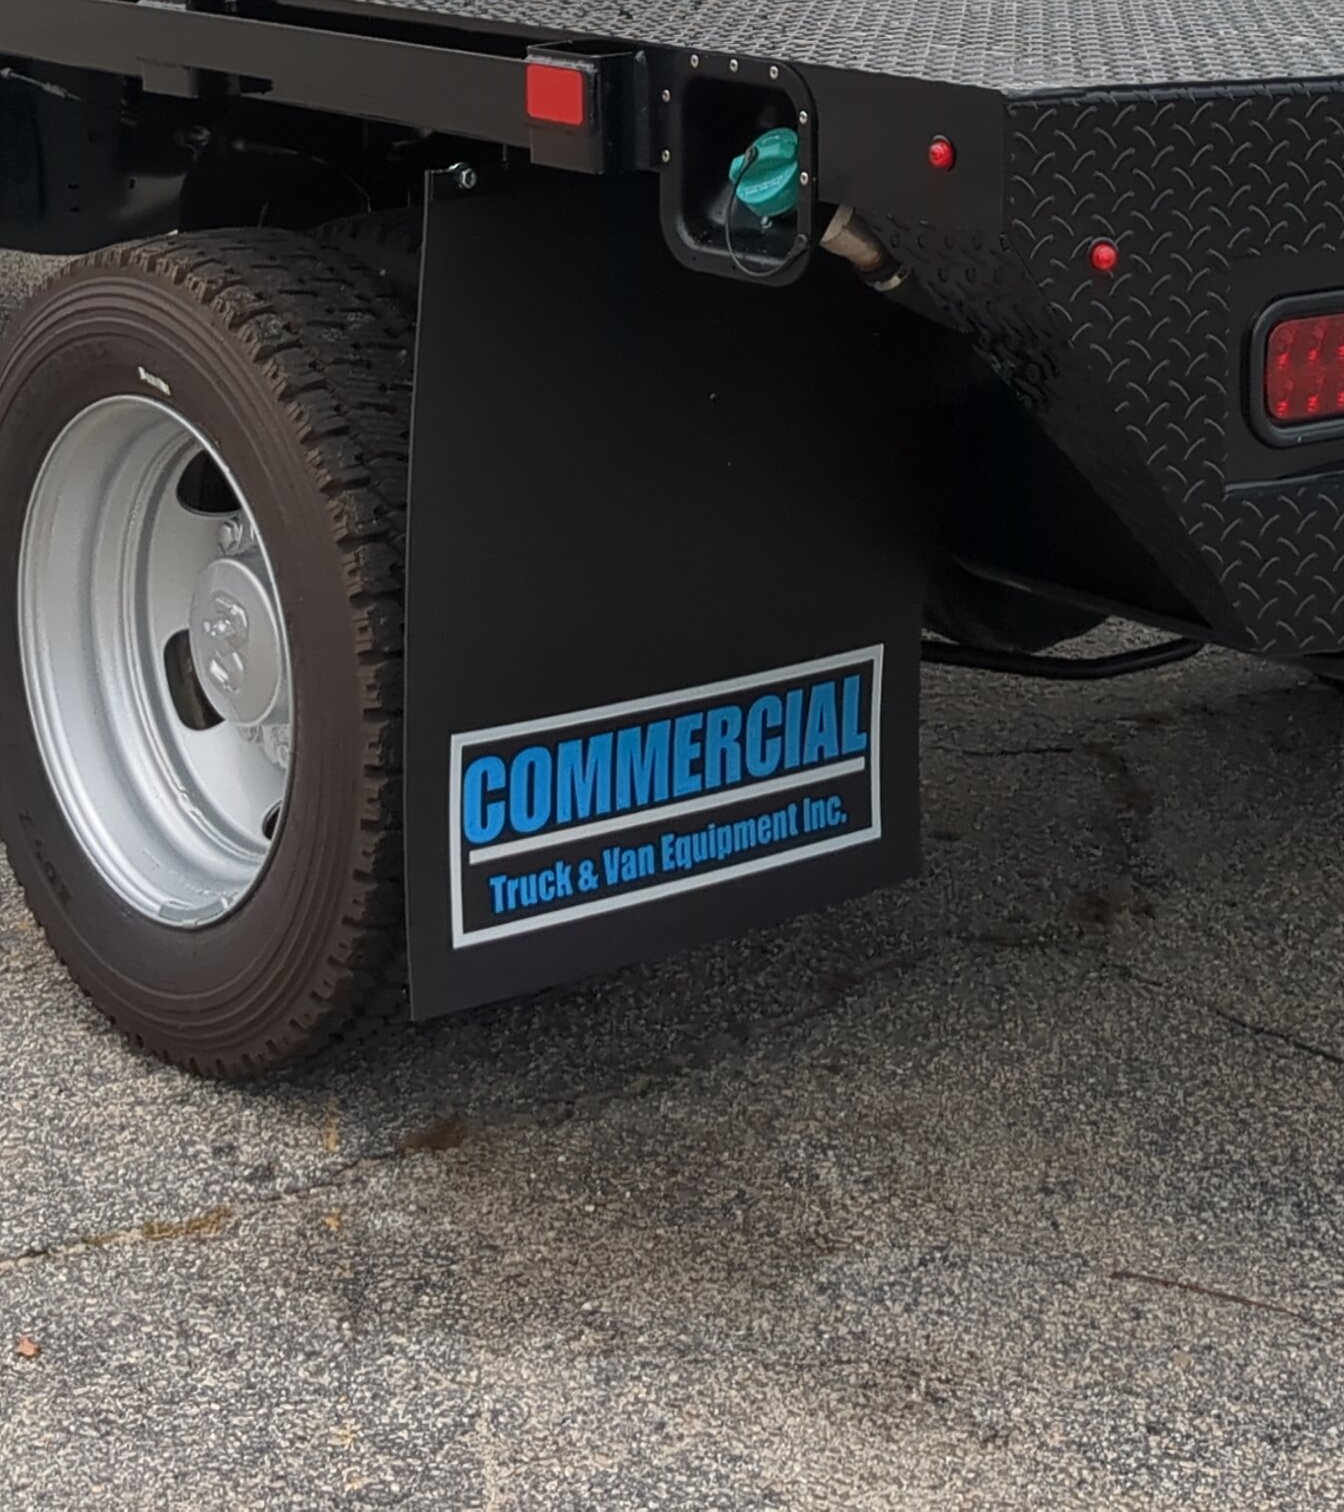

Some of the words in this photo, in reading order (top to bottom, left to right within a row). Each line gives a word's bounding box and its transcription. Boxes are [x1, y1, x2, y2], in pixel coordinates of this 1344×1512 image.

[463, 675, 868, 844] COMMERCIAL
[489, 860, 574, 913] Truck
[577, 860, 599, 892] &
[602, 846, 655, 885] Van
[662, 805, 798, 870] Equipment
[803, 793, 848, 834] Inc.
